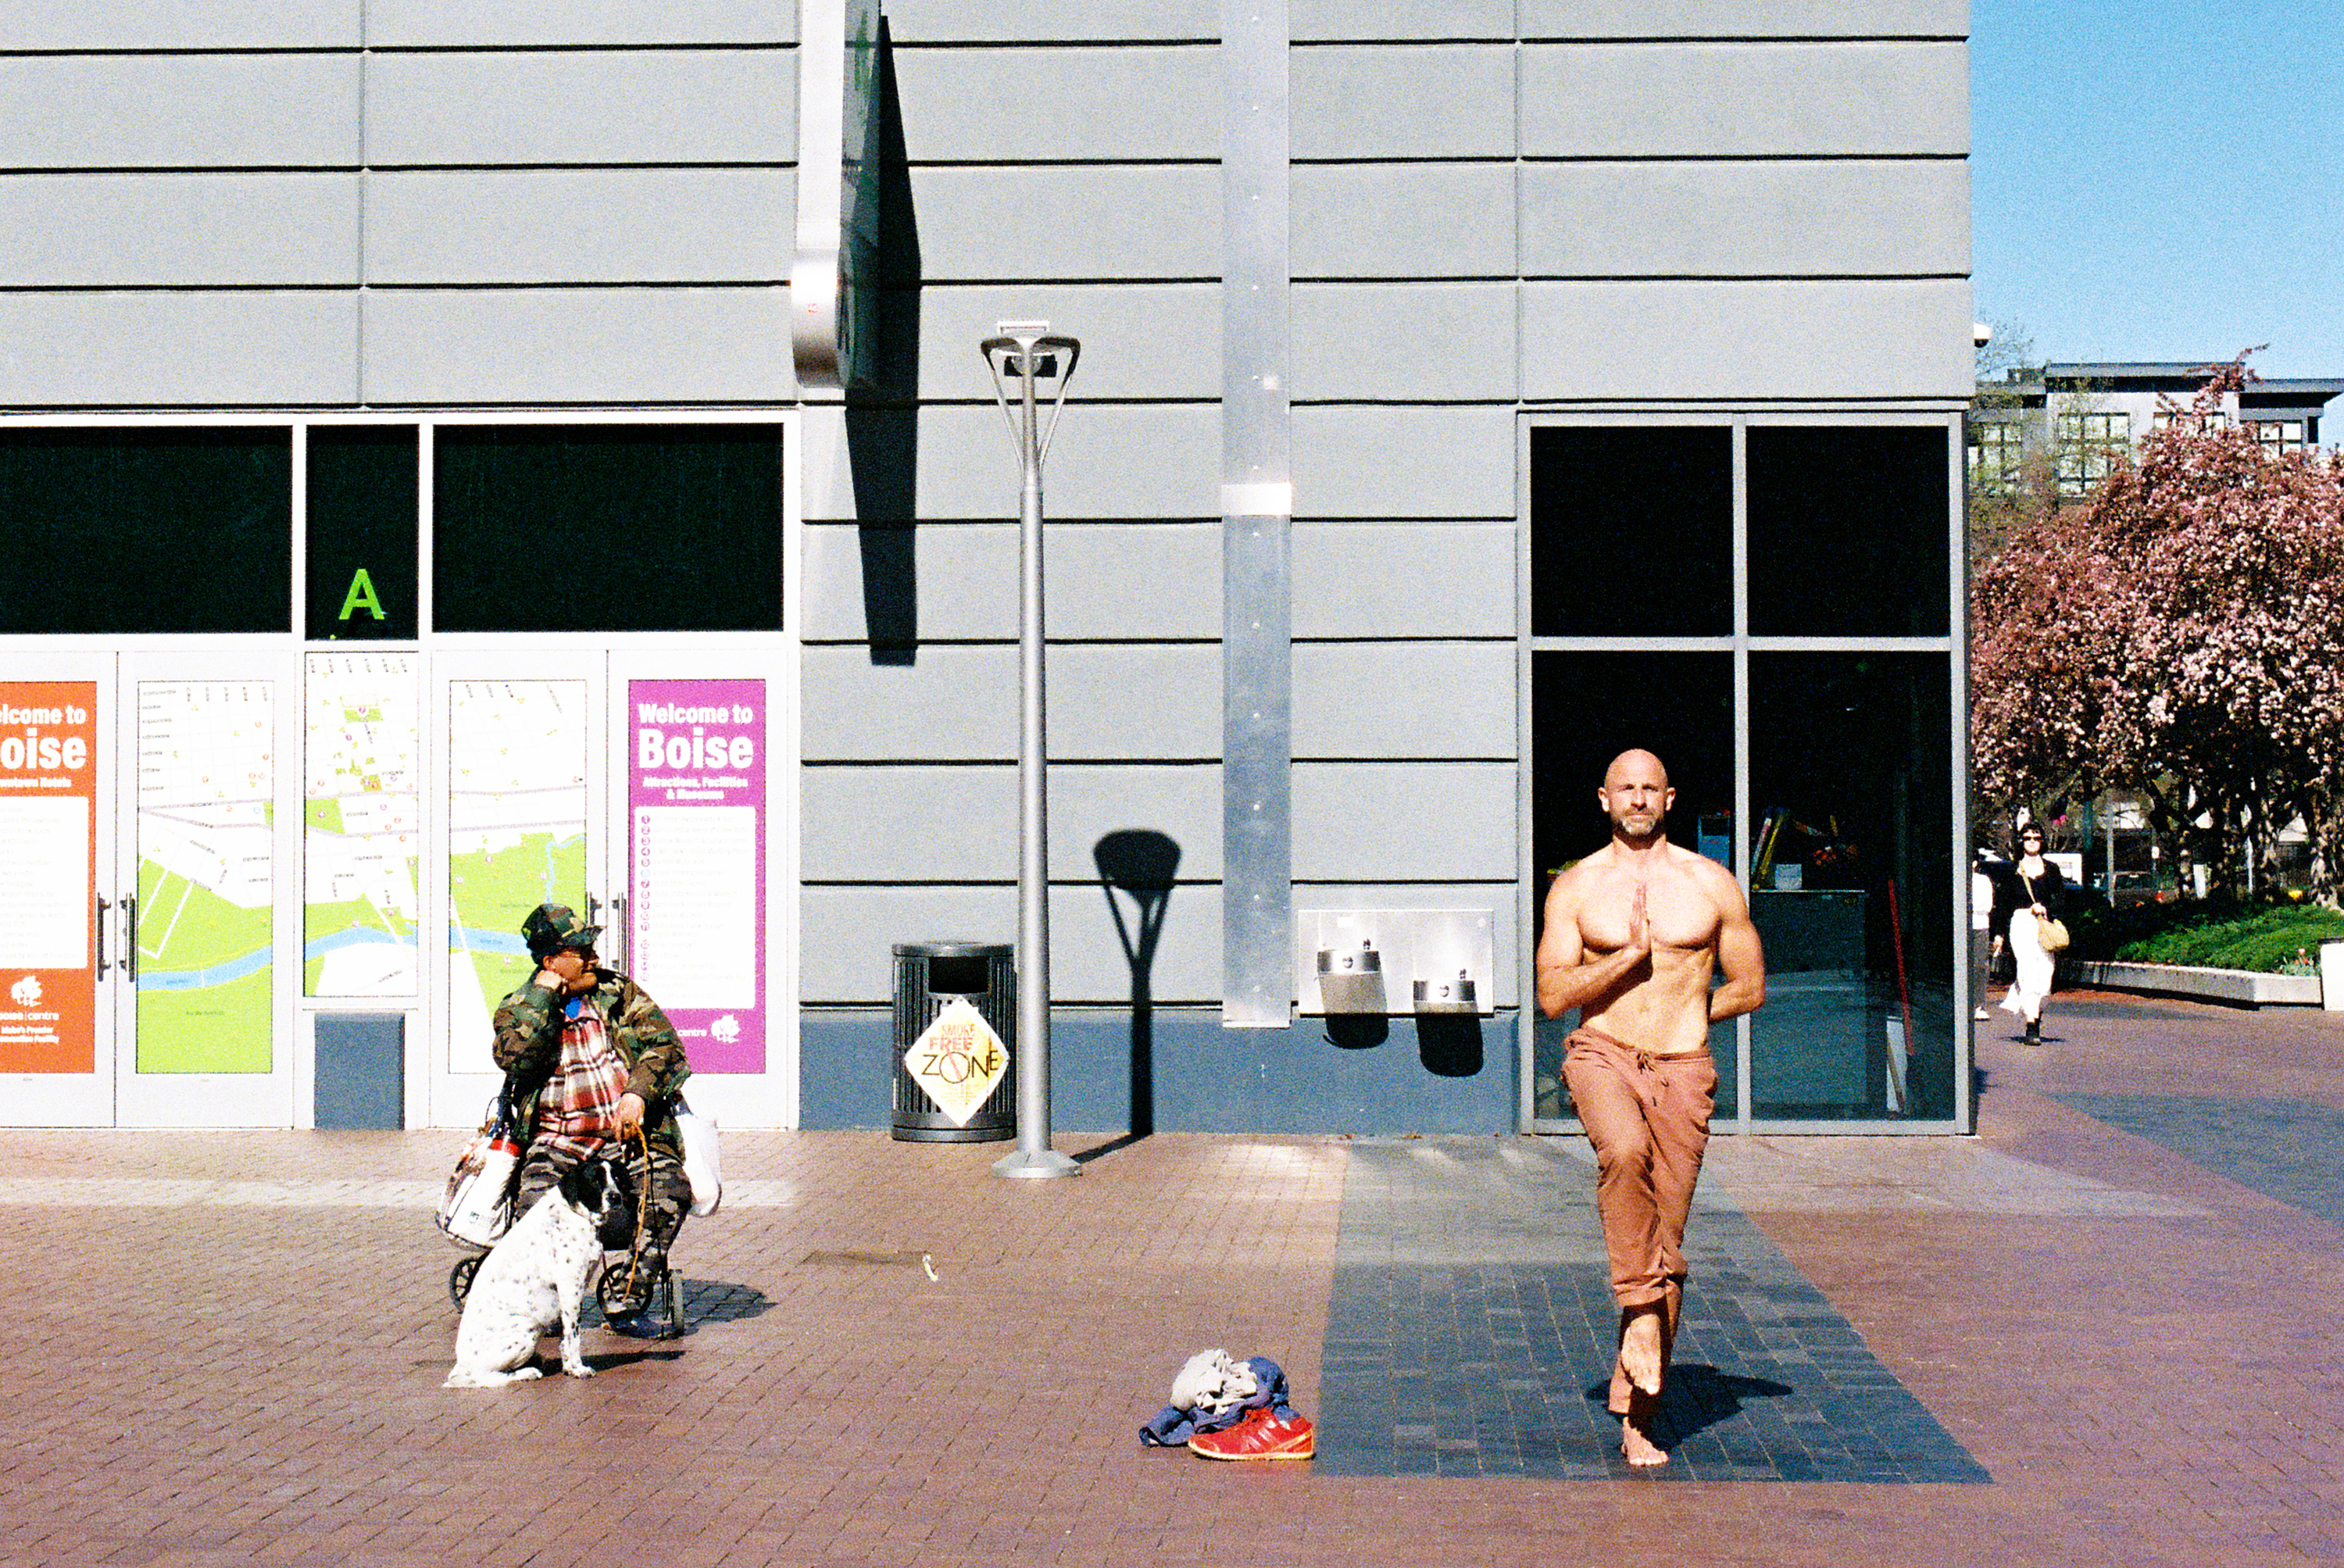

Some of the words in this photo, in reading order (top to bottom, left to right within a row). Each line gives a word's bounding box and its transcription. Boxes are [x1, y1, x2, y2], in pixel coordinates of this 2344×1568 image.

[339, 569, 385, 620] A
[0, 704, 63, 724] lcome
[66, 705, 87, 724] to
[638, 703, 729, 723] Welcome
[731, 705, 753, 723] to
[0, 727, 87, 770] oise
[638, 727, 755, 770] Boise
[0, 777, 39, 788] wntown
[642, 777, 702, 788] Attractions,
[666, 788, 676, 800] &
[27, 1011, 59, 1020] centre
[677, 1028, 707, 1038] centre
[942, 1023, 976, 1037] SMOKE
[929, 1037, 974, 1051] FREE
[921, 1049, 999, 1084] ZONE
